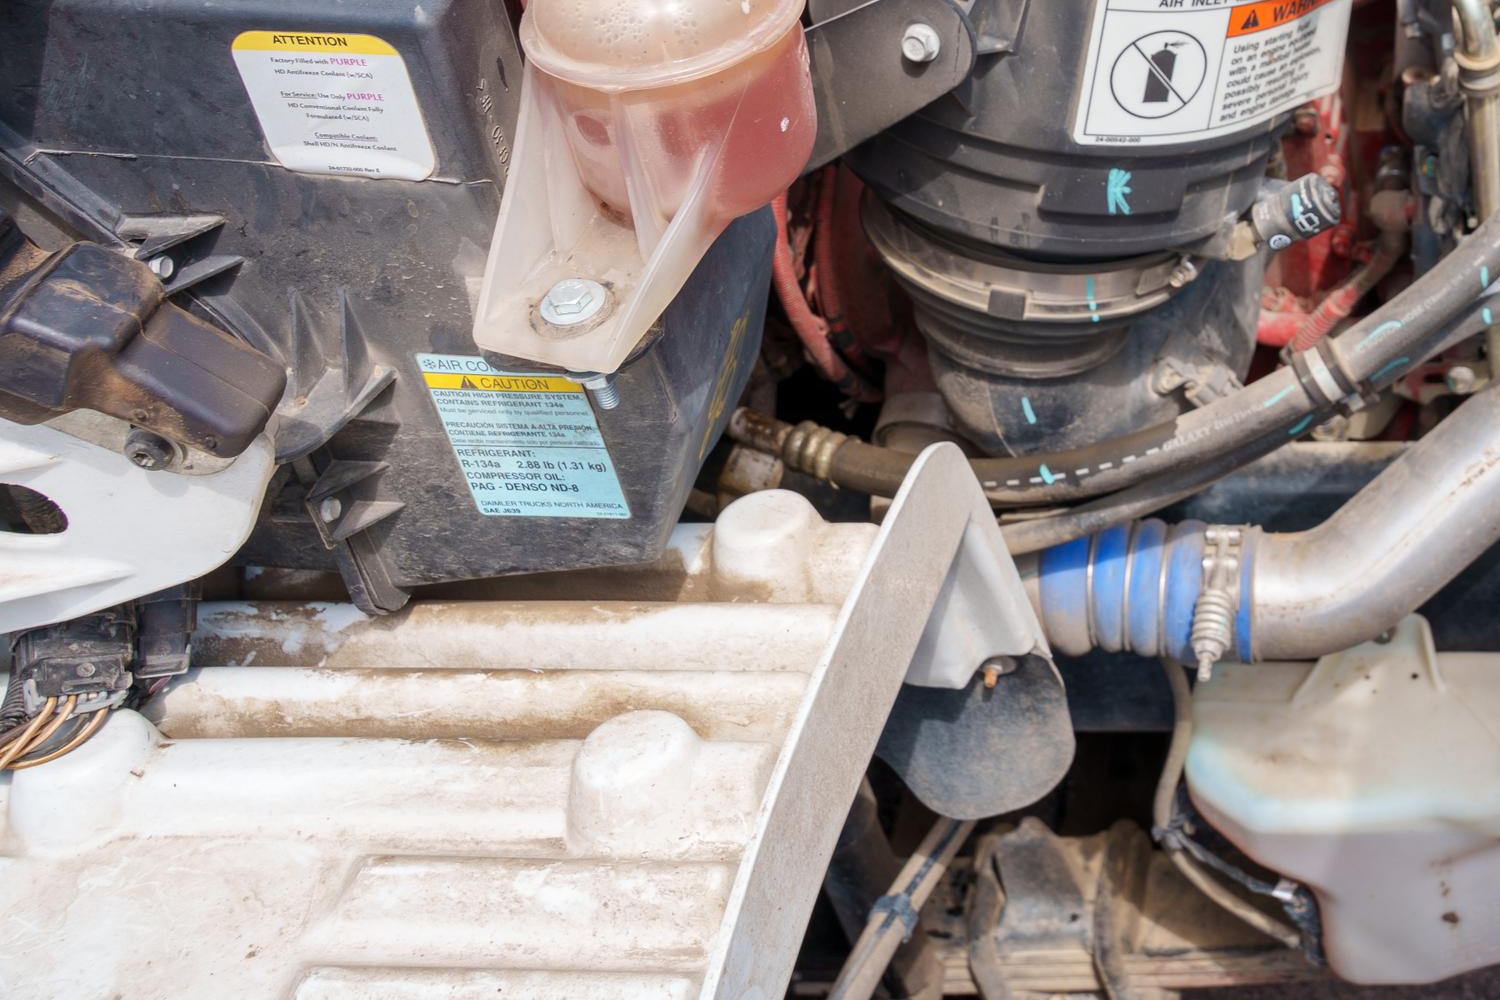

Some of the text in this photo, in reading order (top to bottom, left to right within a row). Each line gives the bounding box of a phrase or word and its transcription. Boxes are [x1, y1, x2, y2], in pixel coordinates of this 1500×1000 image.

[272, 34, 348, 47] ATTENTION
[1233, 41, 1259, 54] Using
[1264, 30, 1293, 46] starting
[1231, 57, 1243, 65] on
[1246, 53, 1257, 62] an
[1261, 44, 1286, 57] engine
[270, 56, 294, 65] Factory
[295, 57, 313, 65] Filled
[329, 57, 367, 67] PURPLE
[286, 68, 319, 76] Antifreeze
[346, 71, 373, 80] (w/SCA)
[1229, 65, 1247, 76] with
[1226, 75, 1251, 88] could
[1254, 68, 1276, 81] cause
[280, 90, 291, 98] For
[292, 90, 317, 99] Service:
[330, 93, 345, 101] Only
[346, 92, 384, 102] PURPLE
[1222, 97, 1251, 110] severe
[1255, 83, 1286, 101] personal
[1224, 83, 1261, 100] possibly
[300, 103, 342, 111] Conventional
[342, 104, 367, 112] Coolant
[368, 106, 384, 114] Fully
[1219, 111, 1236, 122] and
[1240, 102, 1266, 116] engine
[306, 112, 370, 122] Formulated (w/SCA)
[314, 131, 350, 141] Compatible
[339, 142, 371, 150] Antifreeze
[437, 359, 462, 371] AIR
[480, 377, 550, 390] CAUTION
[433, 390, 471, 399] CAUTION
[472, 391, 494, 400] HIGH
[495, 392, 543, 401] PRESSURE
[436, 398, 564, 409] CONTAINS REFRIGERANT 134a
[440, 406, 456, 414] Must
[467, 407, 500, 416] serviced
[496, 421, 529, 431] SISTEMA
[448, 428, 566, 439] CONTIENE REFRIGERANTE 134a
[1162, 423, 1212, 451] GALAXY
[458, 449, 536, 458] REFRIGERANT:
[462, 459, 607, 473] R-134a 2.88 lb (1.31 kg)
[467, 471, 566, 482] COMPRESSOR OIL:
[471, 482, 496, 491] PAG
[505, 483, 547, 492] DENSO
[550, 484, 579, 493] ND-8
[481, 500, 518, 508] DAIMLER
[519, 501, 552, 509] TRUCKS
[585, 502, 624, 510] AMERICA
